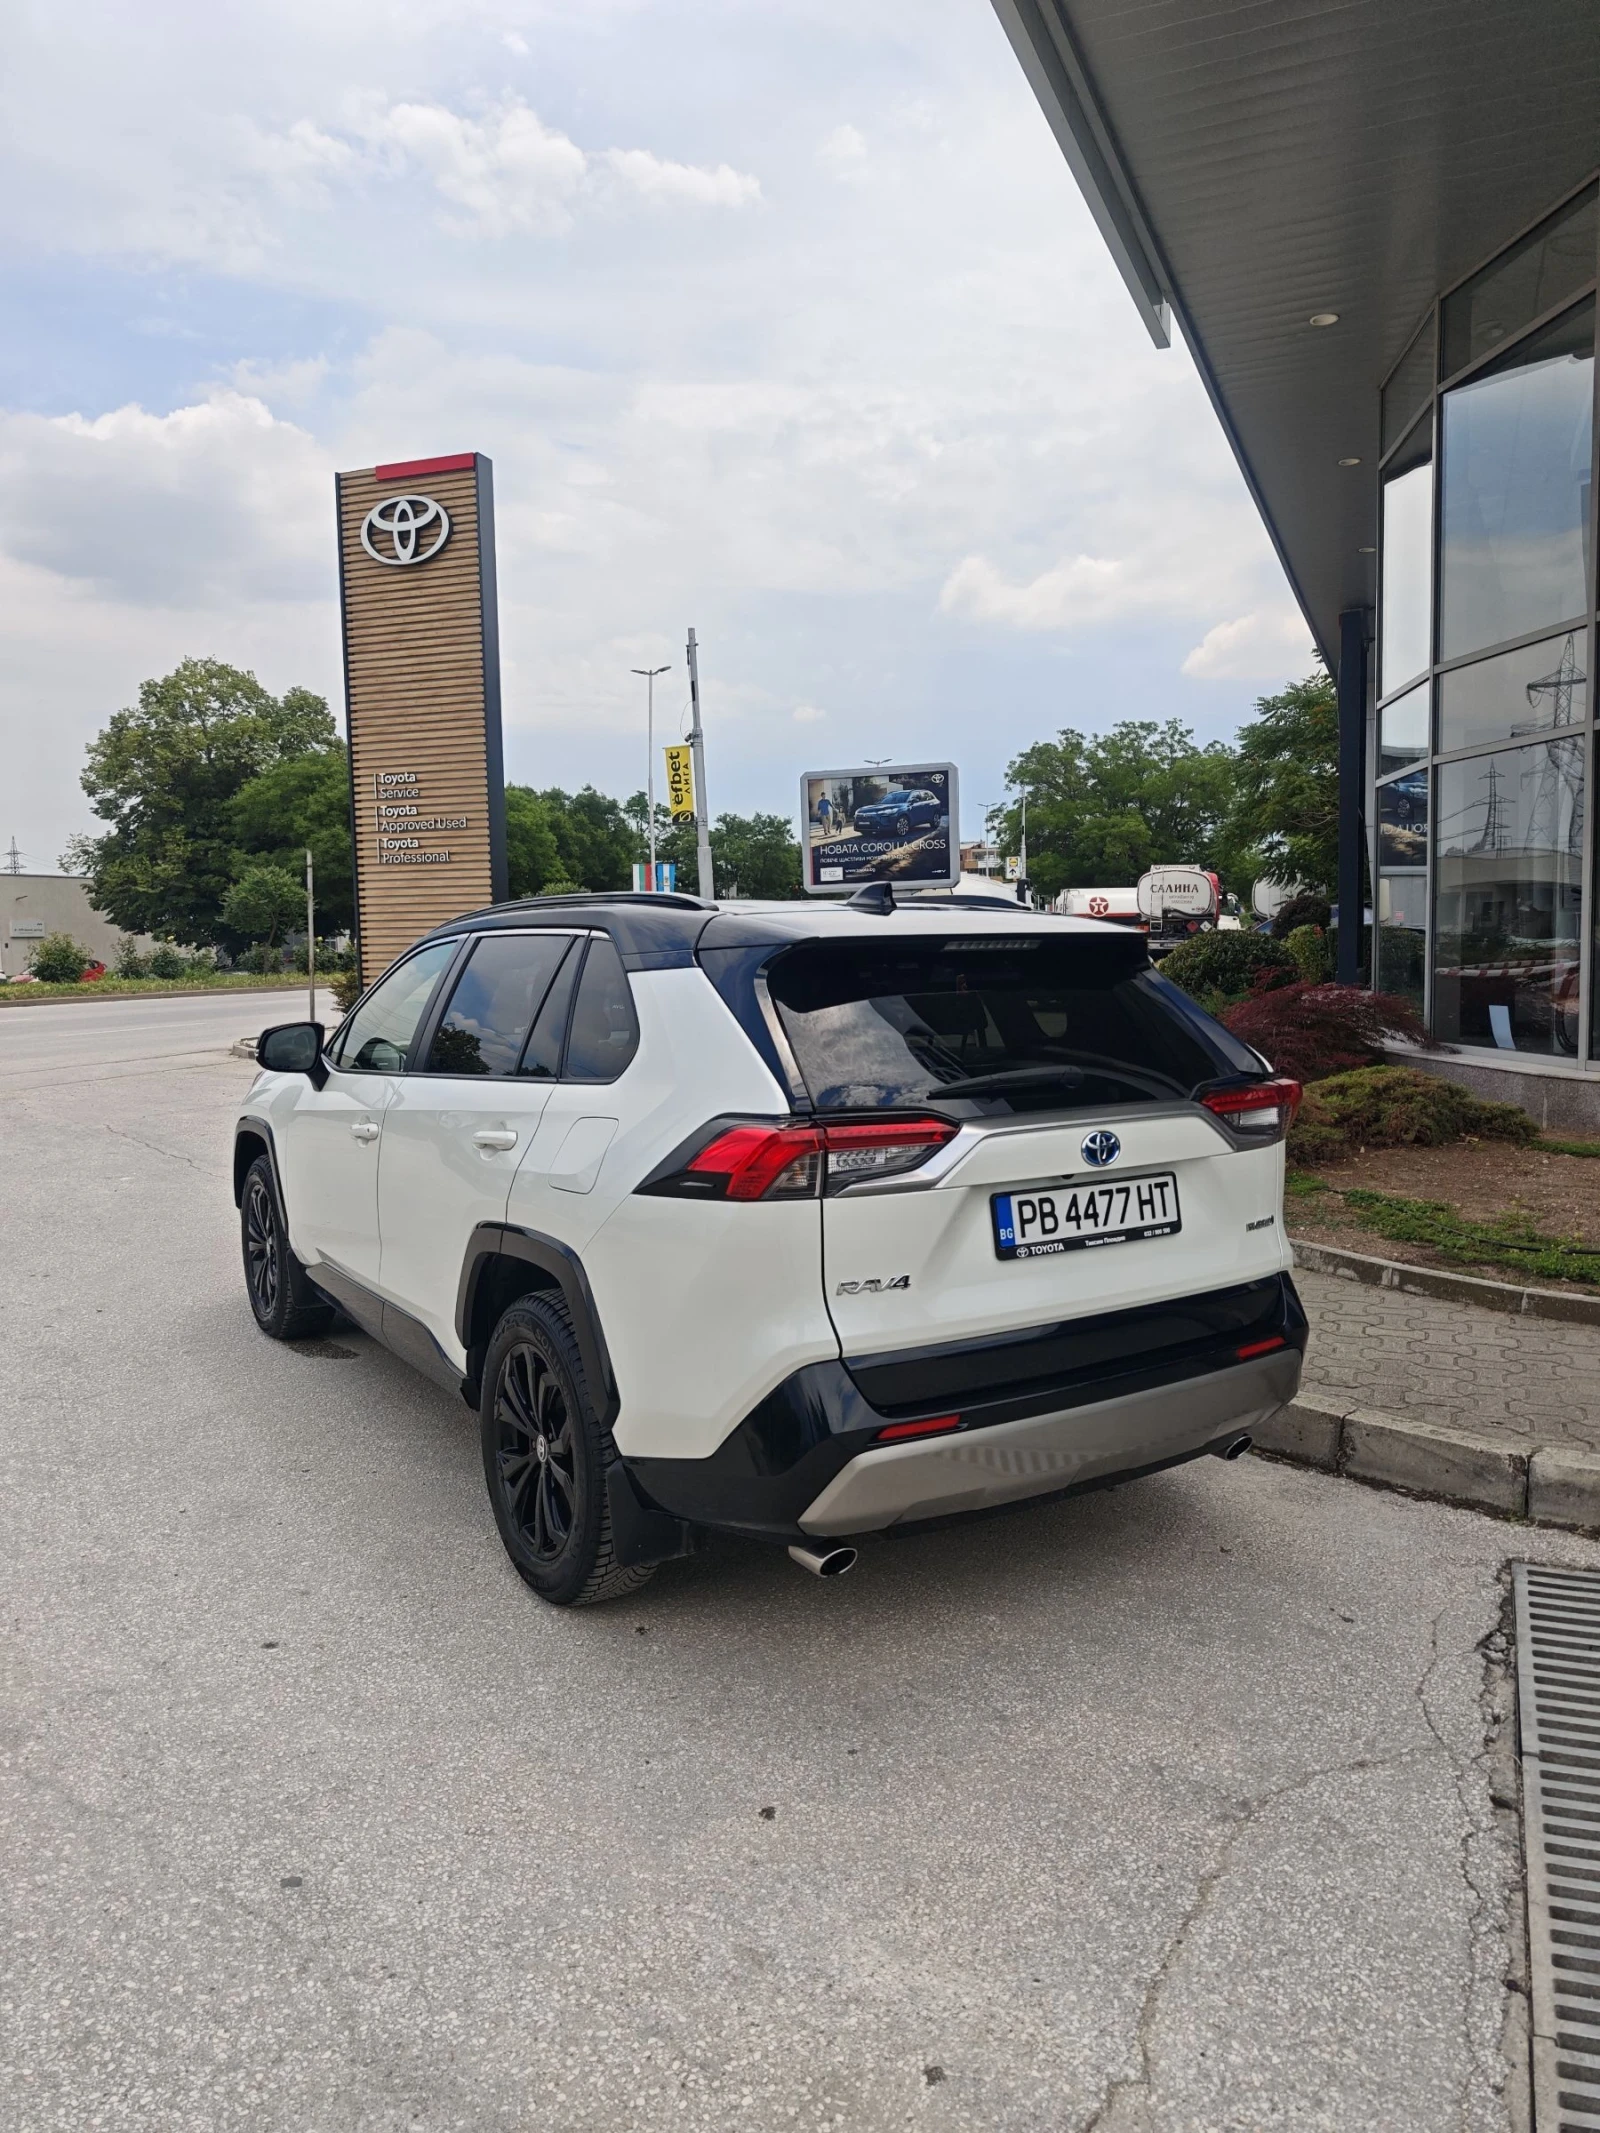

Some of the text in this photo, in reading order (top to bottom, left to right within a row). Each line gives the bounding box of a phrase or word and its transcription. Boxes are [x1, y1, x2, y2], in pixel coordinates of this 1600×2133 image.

[379, 772, 416, 786] Toyota
[668, 751, 684, 806] efbet
[682, 762, 691, 794] ЛИГА
[380, 787, 419, 799] Service
[380, 805, 418, 819] Toyota
[381, 816, 467, 834] Approved Used
[382, 837, 419, 852] Toyota
[820, 839, 946, 855] НОВАТА COROLLA CROSS
[383, 850, 450, 864] Professional
[1151, 884, 1199, 893] САЛИНА
[1017, 1181, 1169, 1238] PB 4477 HT
[1000, 1228, 1014, 1240] BG
[1030, 1242, 1065, 1255] TOYOTA
[836, 1274, 911, 1296] RAV4
